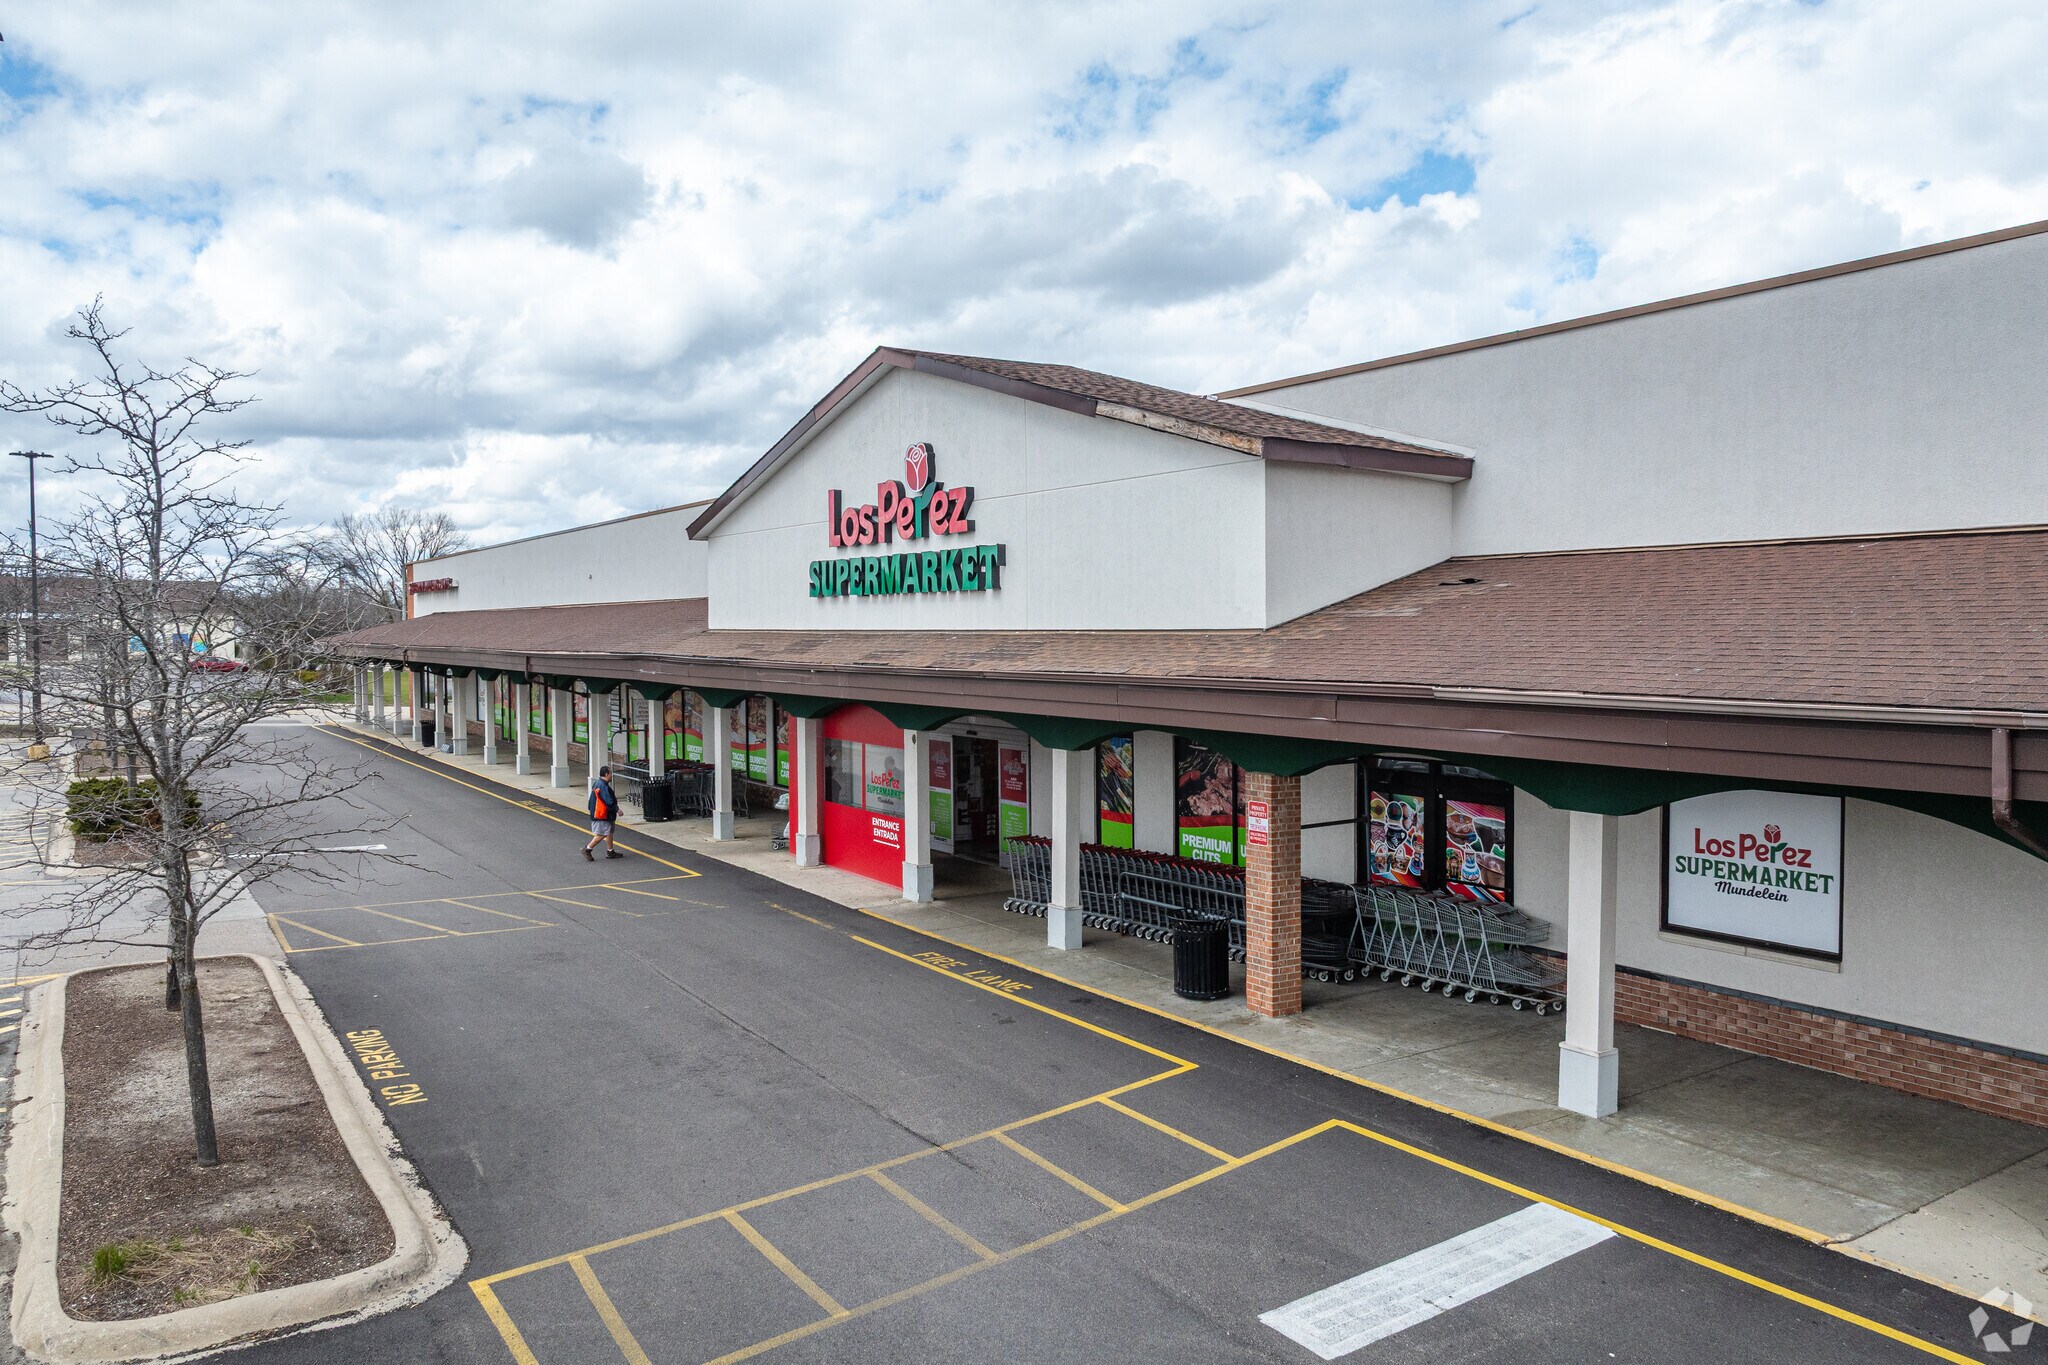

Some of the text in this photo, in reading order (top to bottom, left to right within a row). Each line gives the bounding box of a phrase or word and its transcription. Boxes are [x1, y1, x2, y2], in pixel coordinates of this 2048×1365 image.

[828, 480, 975, 547] Los Perez
[809, 543, 1006, 597] SUPERMARKET
[1251, 805, 1266, 813] PRIVATE
[872, 817, 900, 832] ENTRANCE
[873, 827, 899, 842] ENTRADA
[1182, 833, 1231, 855] PREMIUM
[1192, 848, 1222, 864] CUTS
[1694, 827, 1812, 868] Los Perez
[1675, 855, 1834, 894] SUPERMARKET
[1714, 880, 1789, 902] Mundelein
[912, 951, 1033, 993] FIRE LANE
[346, 1029, 428, 1106] NO PARKING
